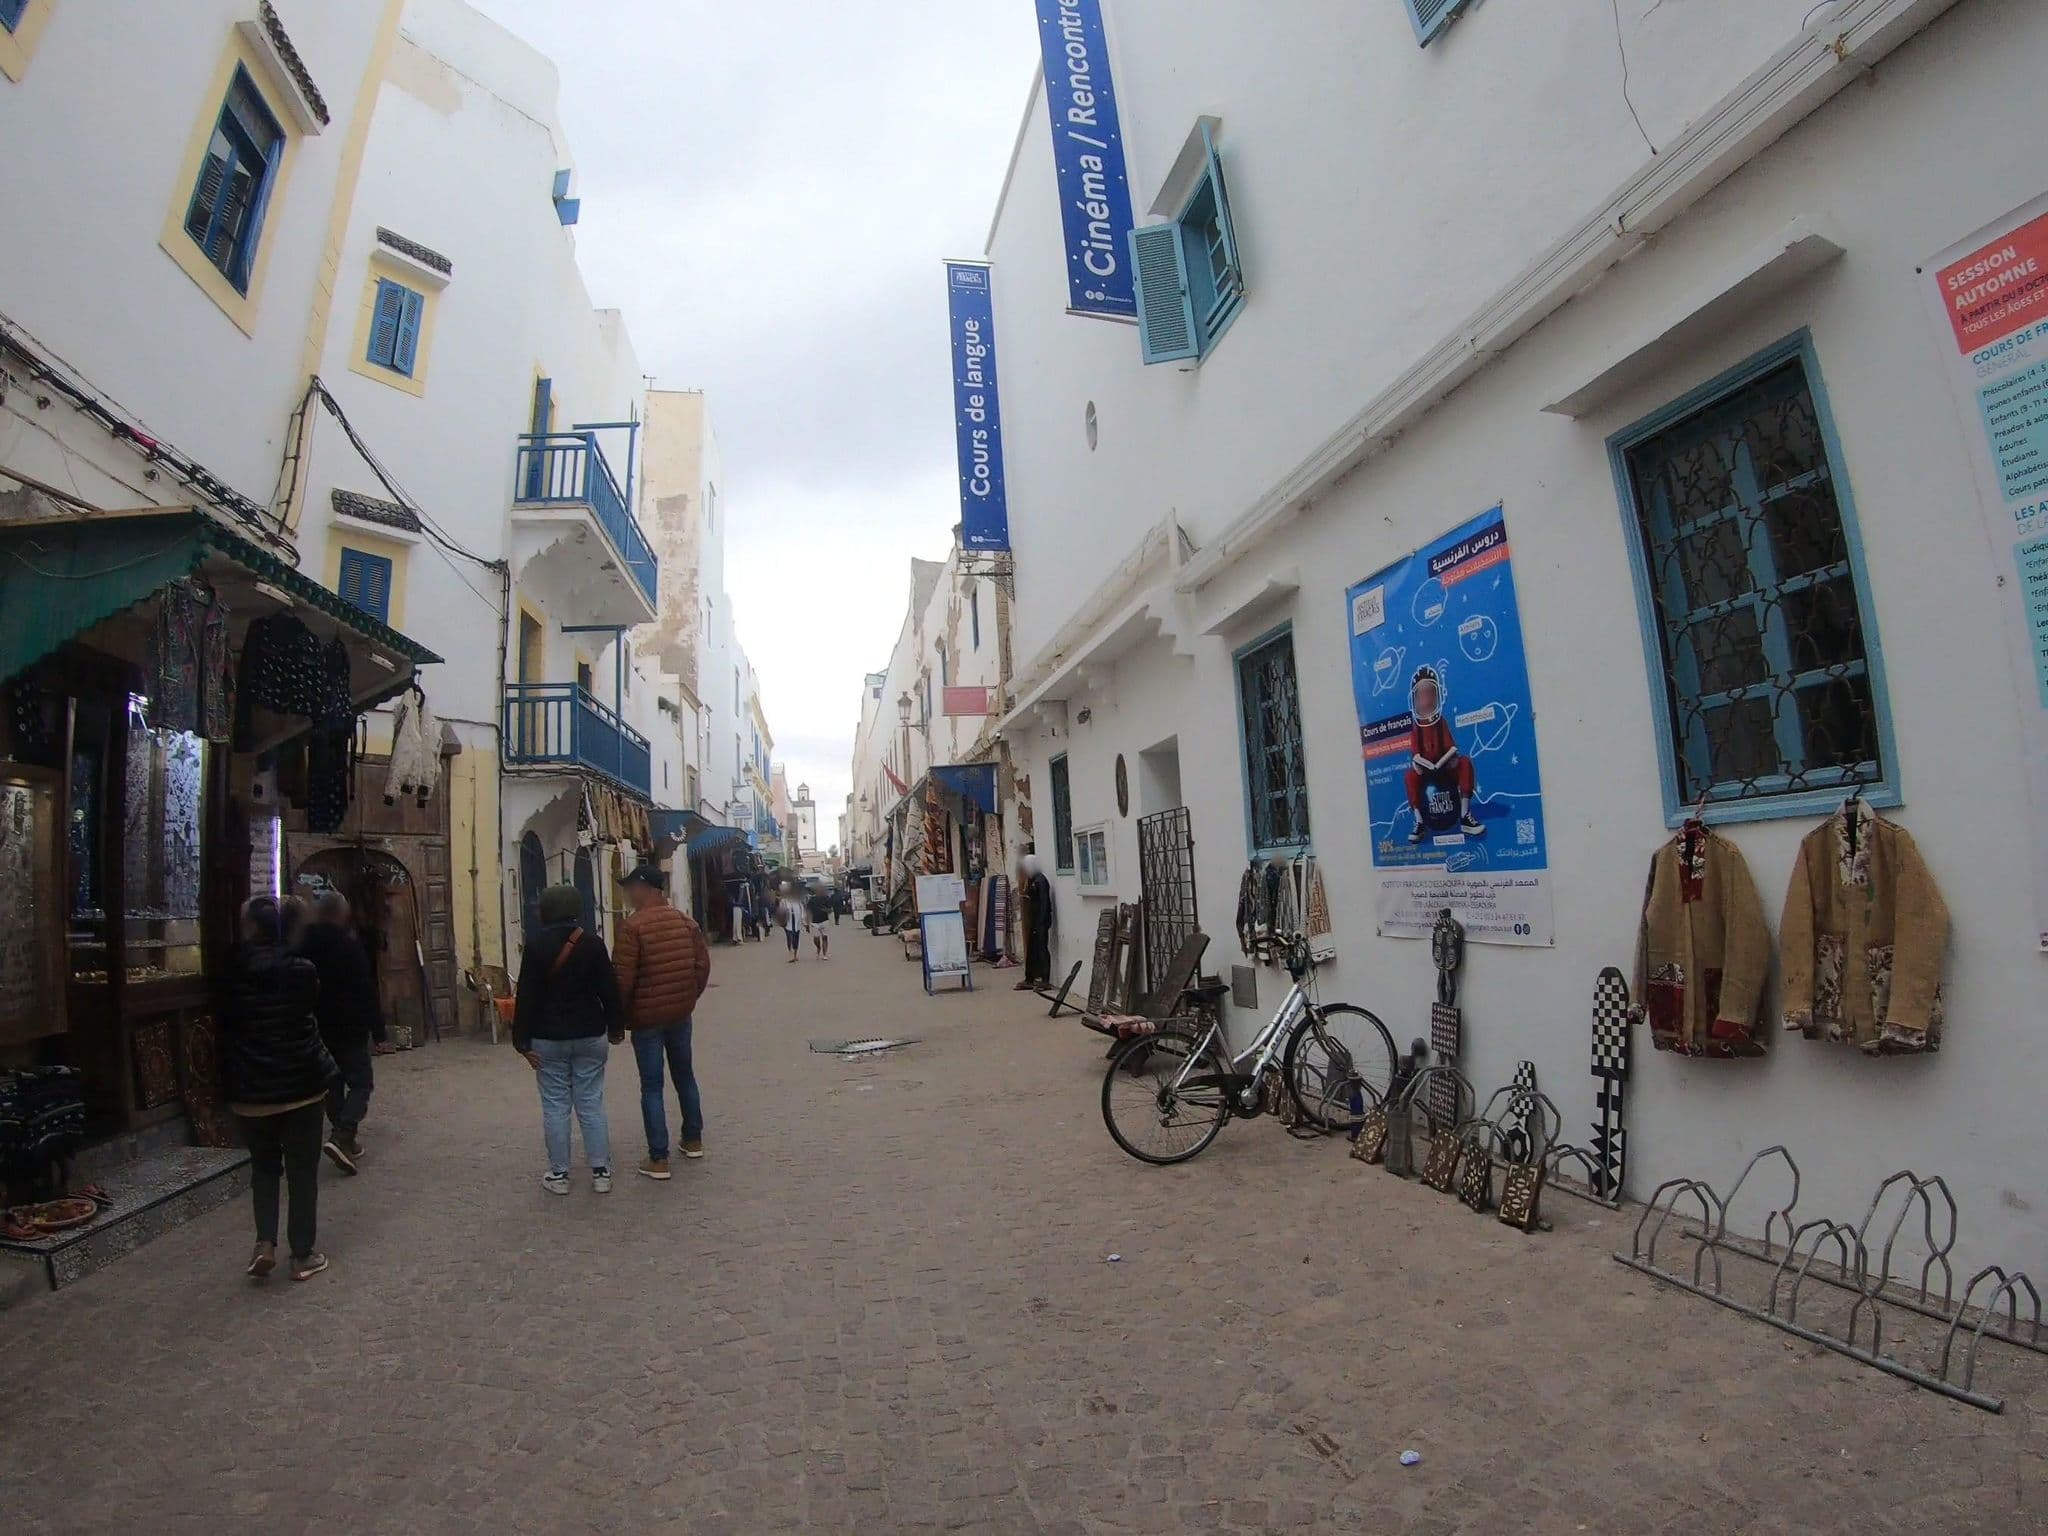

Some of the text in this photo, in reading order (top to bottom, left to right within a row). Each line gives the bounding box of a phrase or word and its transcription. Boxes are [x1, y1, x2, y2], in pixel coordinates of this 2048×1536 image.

[1076, 154, 1116, 276] Cinéma
[1948, 246, 2017, 290] SESSION
[1955, 258, 2038, 310] AUTOMNE
[1969, 299, 2000, 320] PARTIR
[1963, 317, 1989, 334] TOUS
[1990, 309, 2006, 324] LES
[1973, 338, 2014, 365] COURS
[2015, 329, 2033, 345] DE
[2012, 384, 2042, 401] enfants
[963, 319, 991, 496] Cours de langue
[1990, 409, 2019, 426] Enfants
[1998, 437, 2028, 454] Adultes
[2008, 483, 2032, 497] Cours
[2014, 505, 2036, 522] LES
[1432, 531, 1499, 572] دروس الفرنسية
[1363, 715, 1412, 737] Cours de français
